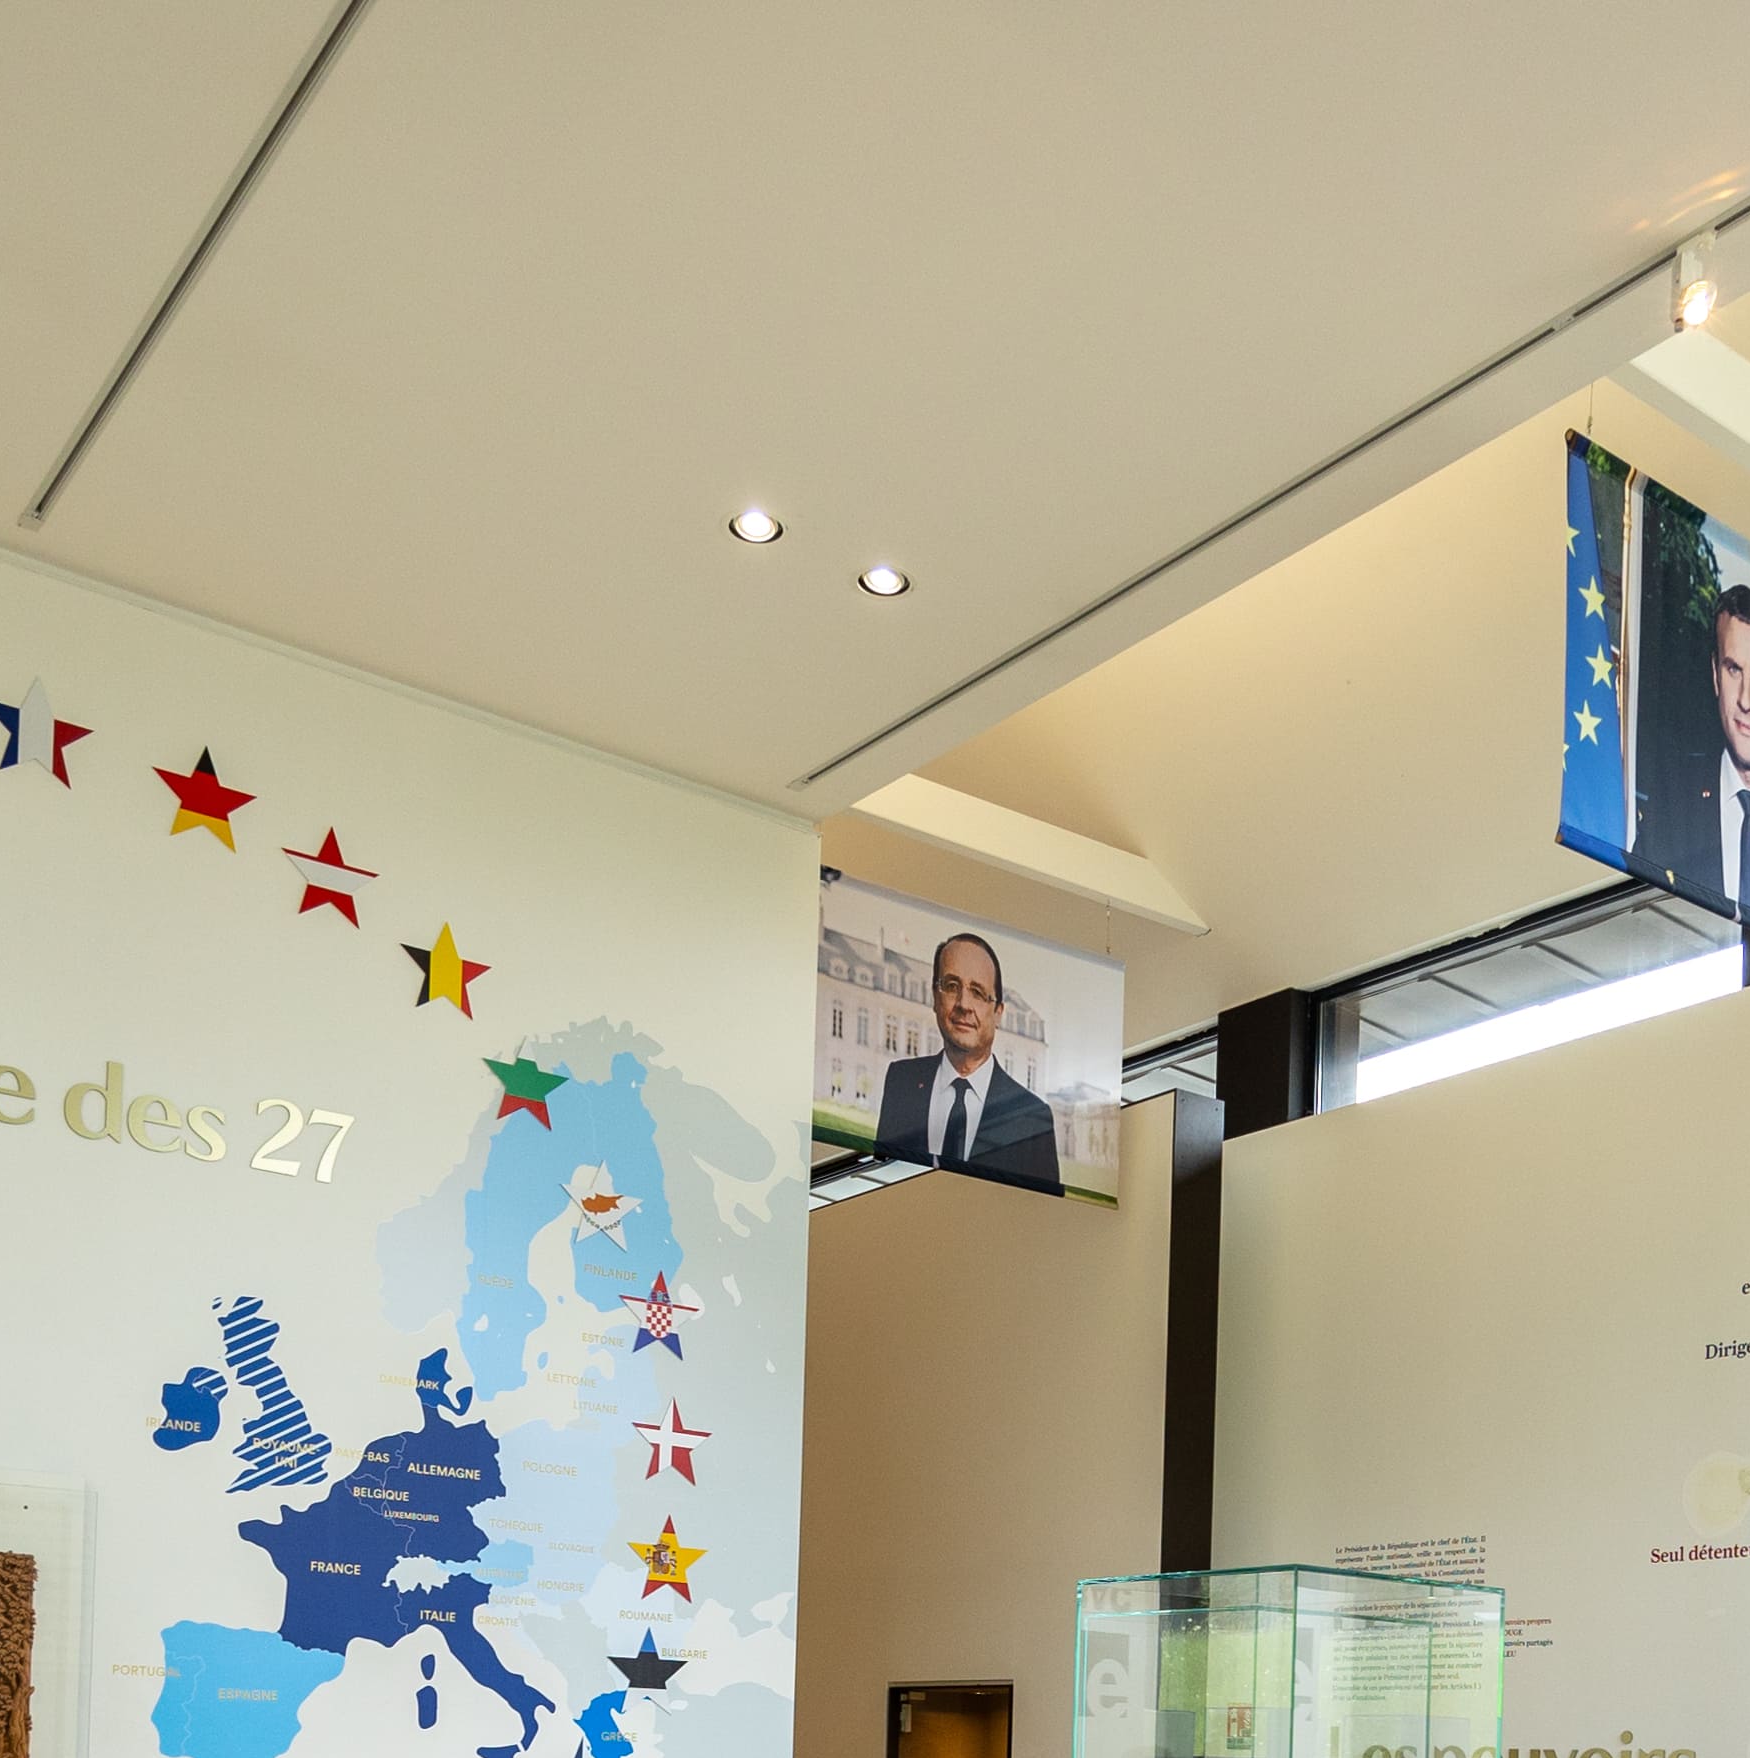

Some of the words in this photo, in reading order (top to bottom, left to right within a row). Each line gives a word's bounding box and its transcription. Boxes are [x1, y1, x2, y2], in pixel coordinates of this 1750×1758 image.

[63, 1060, 228, 1163] des
[250, 1099, 356, 1184] 27
[584, 1264, 638, 1281] FINLANDE
[379, 1374, 440, 1391] DANEMARK
[146, 1417, 201, 1433] IRLANDE
[335, 1447, 390, 1464] PAYS-BAS
[407, 1463, 481, 1480] ALLEMAGNE
[523, 1461, 578, 1477] POLOGNE
[353, 1487, 410, 1502] BELGIQUE
[384, 1510, 440, 1523] LUXEMBOURG
[1650, 1546, 1685, 1563] Seul
[310, 1561, 361, 1576] FRANCE
[537, 1580, 585, 1593] HONGRIE
[420, 1610, 456, 1623] ITALIE
[619, 1610, 673, 1623] ROUMANIE
[661, 1647, 708, 1660] BULGARIE
[112, 1665, 181, 1677] PORTUGAL
[218, 1689, 278, 1701] ESPAGNE
